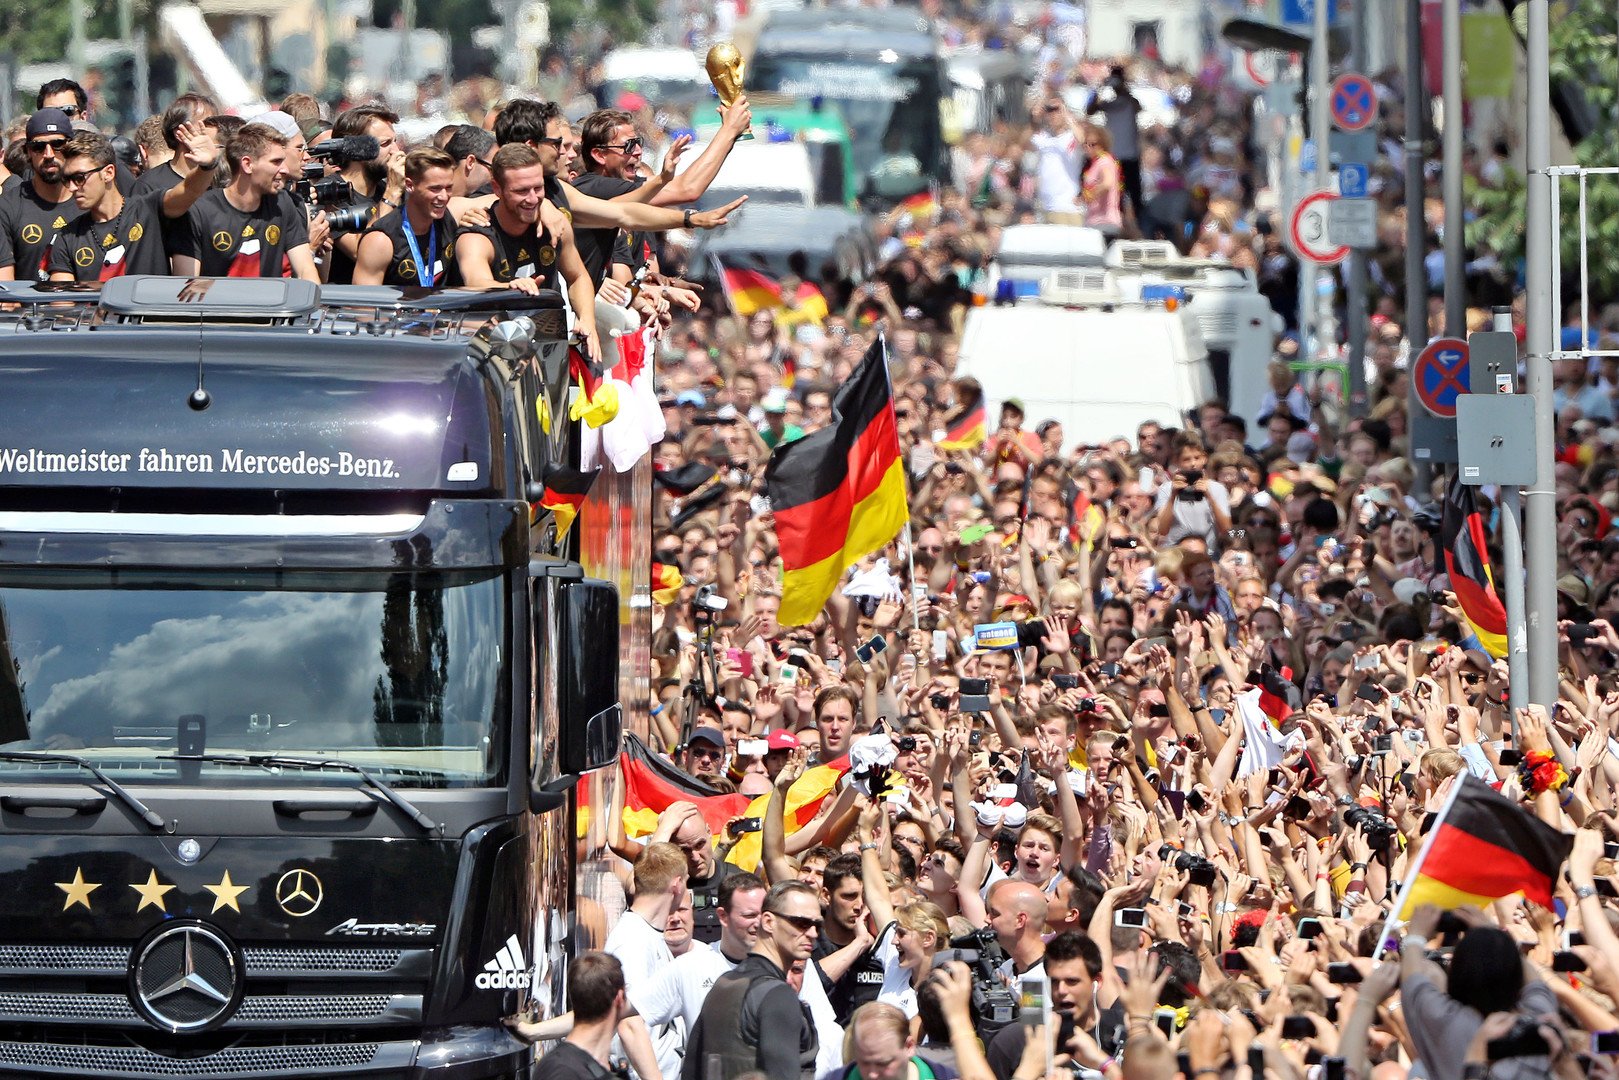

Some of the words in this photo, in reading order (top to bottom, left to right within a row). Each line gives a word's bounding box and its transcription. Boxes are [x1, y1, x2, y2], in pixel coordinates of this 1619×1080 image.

[0, 448, 131, 473] Weltmeister
[138, 447, 213, 473] fahren
[220, 449, 400, 479] Mercedes-Benz.
[474, 967, 531, 990] adidas
